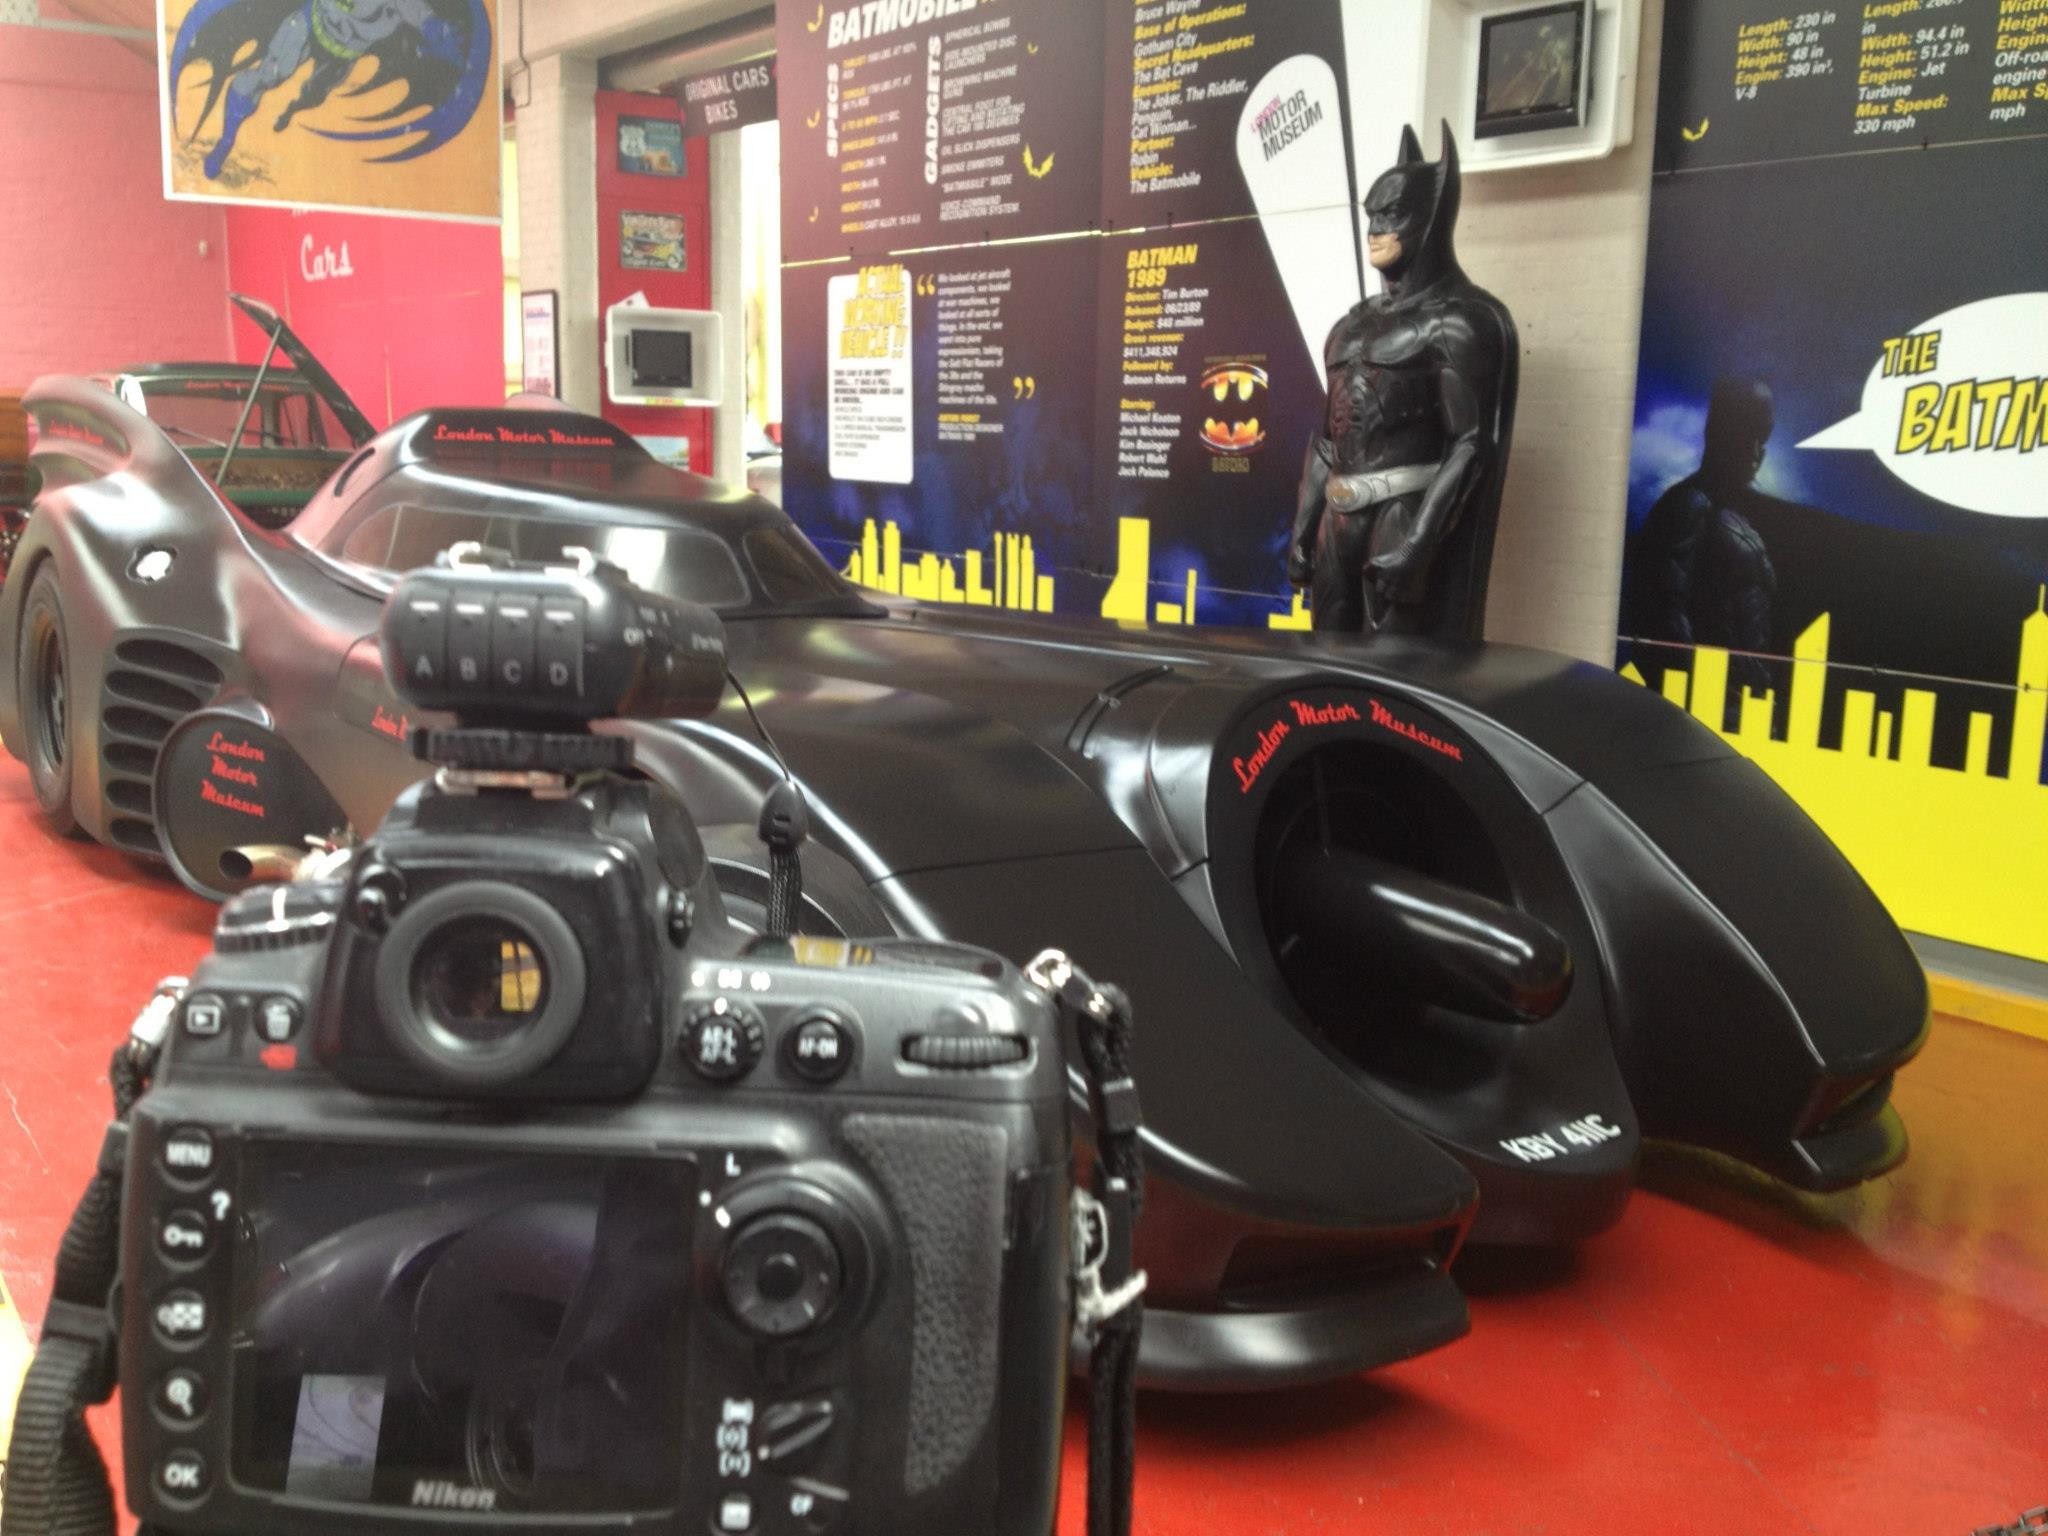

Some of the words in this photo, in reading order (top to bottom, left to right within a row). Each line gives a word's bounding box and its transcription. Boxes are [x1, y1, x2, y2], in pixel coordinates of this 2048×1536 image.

[827, 0, 977, 49] BATMOBI
[1135, 6, 1164, 23] Bruce
[1135, 24, 1161, 41] Base
[1163, 16, 1178, 33] of
[1179, 3, 1247, 31] Operations:
[1821, 10, 1836, 25] in
[1786, 31, 1804, 46] 90
[1806, 30, 1819, 43] in
[1861, 21, 1876, 35] in
[1861, 32, 1912, 51] Width:
[1915, 26, 1948, 44] 94.4
[1950, 24, 1965, 39] in
[1997, 31, 2048, 50] Engin
[1134, 39, 1174, 58] Gotham
[1176, 32, 1198, 50] City
[1172, 33, 1255, 62] Headquarters:
[1810, 44, 1824, 59] in
[1859, 49, 1917, 68] Height:
[1920, 43, 1953, 60] 51.2
[1954, 41, 1970, 56] in
[685, 74, 732, 103] ORIGINAL
[733, 65, 770, 92] CARS
[1857, 67, 1917, 86] Engine:
[1921, 61, 1946, 77] Jet
[1993, 67, 2047, 86] engine
[1186, 86, 1206, 102] The
[1207, 78, 1249, 99] Riddler,
[1858, 84, 1912, 101] Turbine
[1992, 86, 2029, 103] Max
[704, 99, 738, 124] BIKES
[924, 34, 942, 185] GADGETS
[1257, 89, 1307, 141] MOTOR
[1855, 102, 1889, 118] Max
[1892, 94, 1949, 115] Speed:
[1990, 102, 2026, 121] mph
[1263, 100, 1323, 161] MUSEUM
[1853, 119, 1881, 134] 330
[1882, 115, 1917, 132] mph
[1130, 181, 1149, 194] The
[300, 233, 354, 283] Cars
[1126, 243, 1198, 269] BATMAN
[1128, 266, 1167, 289] 1989
[1882, 329, 1942, 379] THE
[433, 424, 494, 442] London
[497, 426, 546, 444] Motor
[549, 428, 614, 445] Museum
[415, 655, 433, 676] A
[459, 657, 477, 681] B
[503, 660, 523, 684] C
[550, 662, 569, 686] D
[207, 731, 266, 762] London
[1232, 719, 1291, 793] London
[1290, 700, 1361, 726] Motor
[1370, 700, 1463, 761] Museum
[211, 755, 258, 787] Motor
[201, 779, 265, 817] Museum
[166, 1142, 212, 1168] MENU
[164, 1463, 200, 1488] OK
[411, 1478, 497, 1509] Nikon
